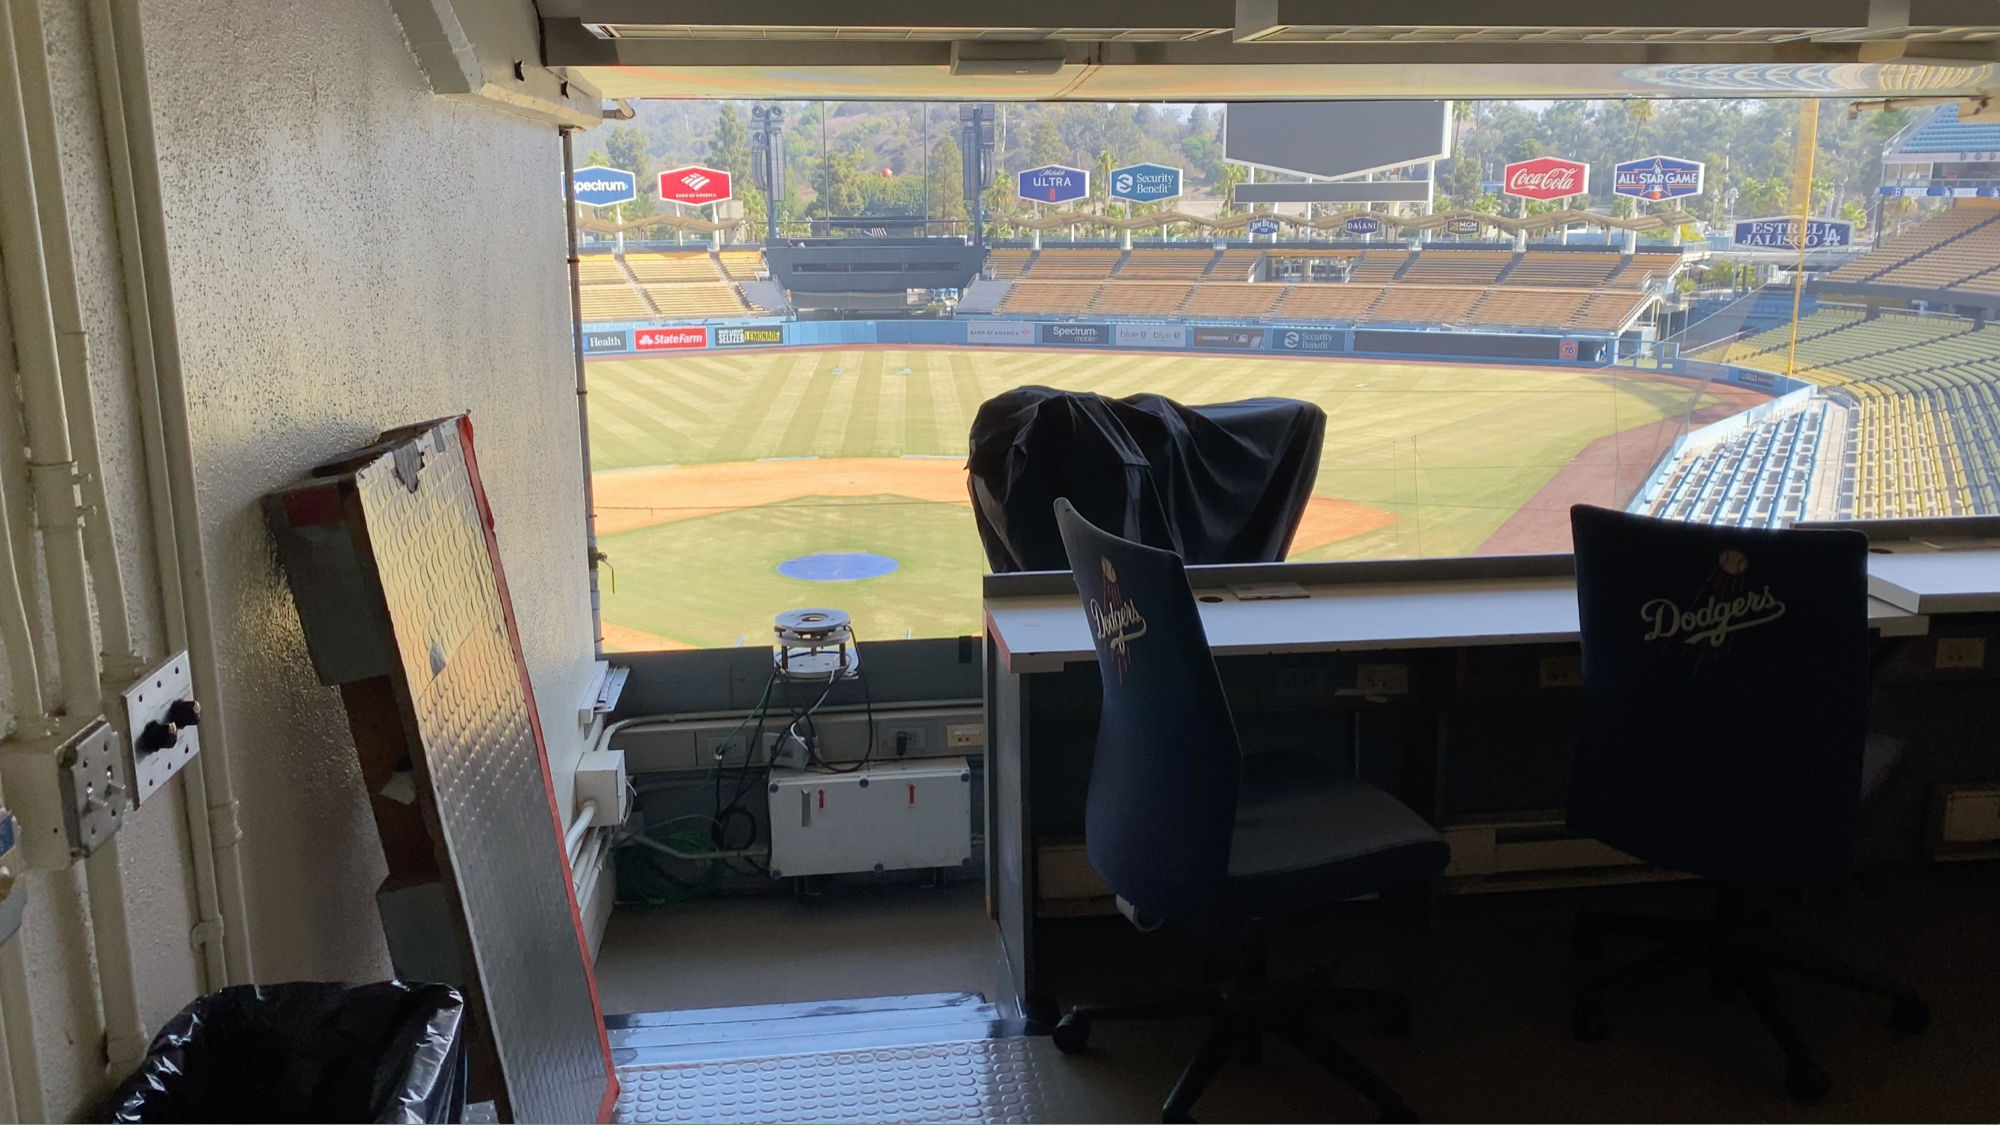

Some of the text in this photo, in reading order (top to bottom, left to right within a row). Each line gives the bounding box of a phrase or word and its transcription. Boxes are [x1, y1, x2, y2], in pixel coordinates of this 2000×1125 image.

[1033, 177, 1072, 187] ULTRA
[1136, 173, 1174, 184] Security
[1618, 172, 1697, 184] ALL STAR GAME
[1136, 184, 1169, 194] Benefit
[1347, 221, 1376, 231] DASANI
[744, 331, 780, 342] LEMONADE
[1052, 326, 1096, 337] Spectrum
[1120, 330, 1139, 338] blue
[1153, 330, 1172, 339] blue
[1302, 332, 1333, 341] Security
[590, 336, 621, 348] Health
[718, 333, 745, 344] SELTZER
[1302, 340, 1328, 349] Benefit
[1564, 345, 1575, 354] 76
[1640, 585, 1786, 647] Dodgers
[1090, 597, 1147, 656] Dodgers
